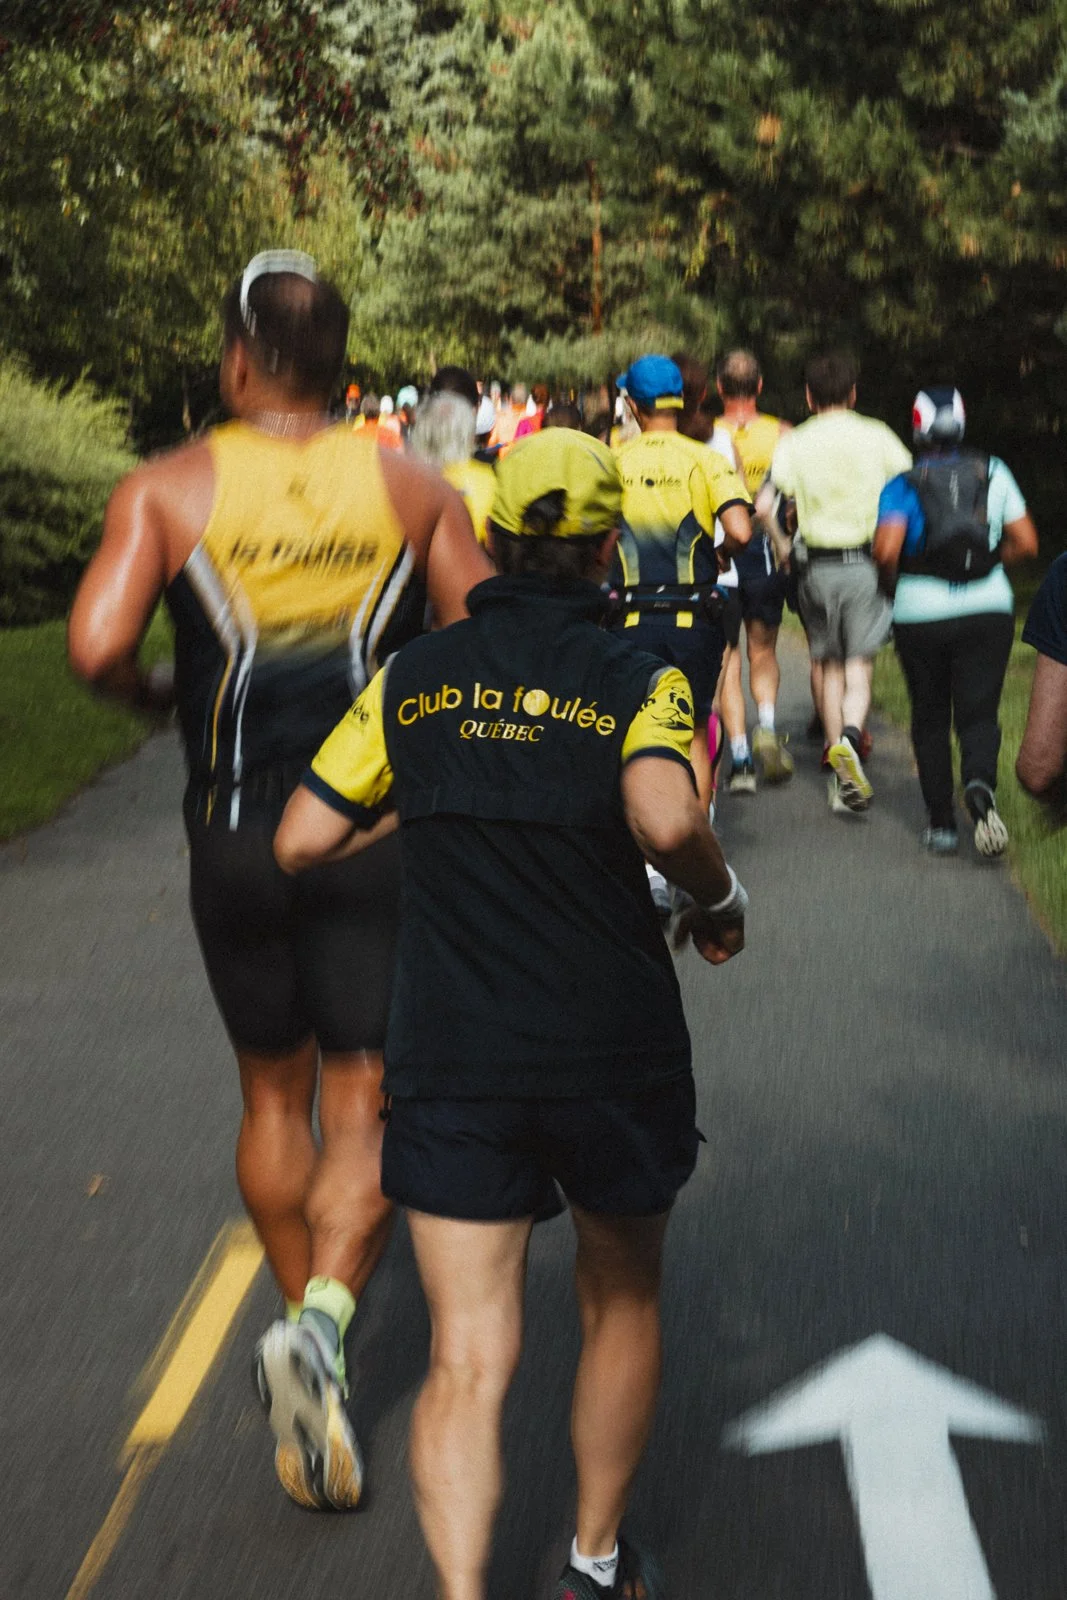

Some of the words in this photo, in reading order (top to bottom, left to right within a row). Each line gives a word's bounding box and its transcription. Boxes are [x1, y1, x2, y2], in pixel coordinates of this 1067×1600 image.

[397, 684, 464, 726] Club
[472, 682, 504, 710] la
[512, 685, 616, 736] foulée
[459, 718, 545, 742] QUÉBEC
